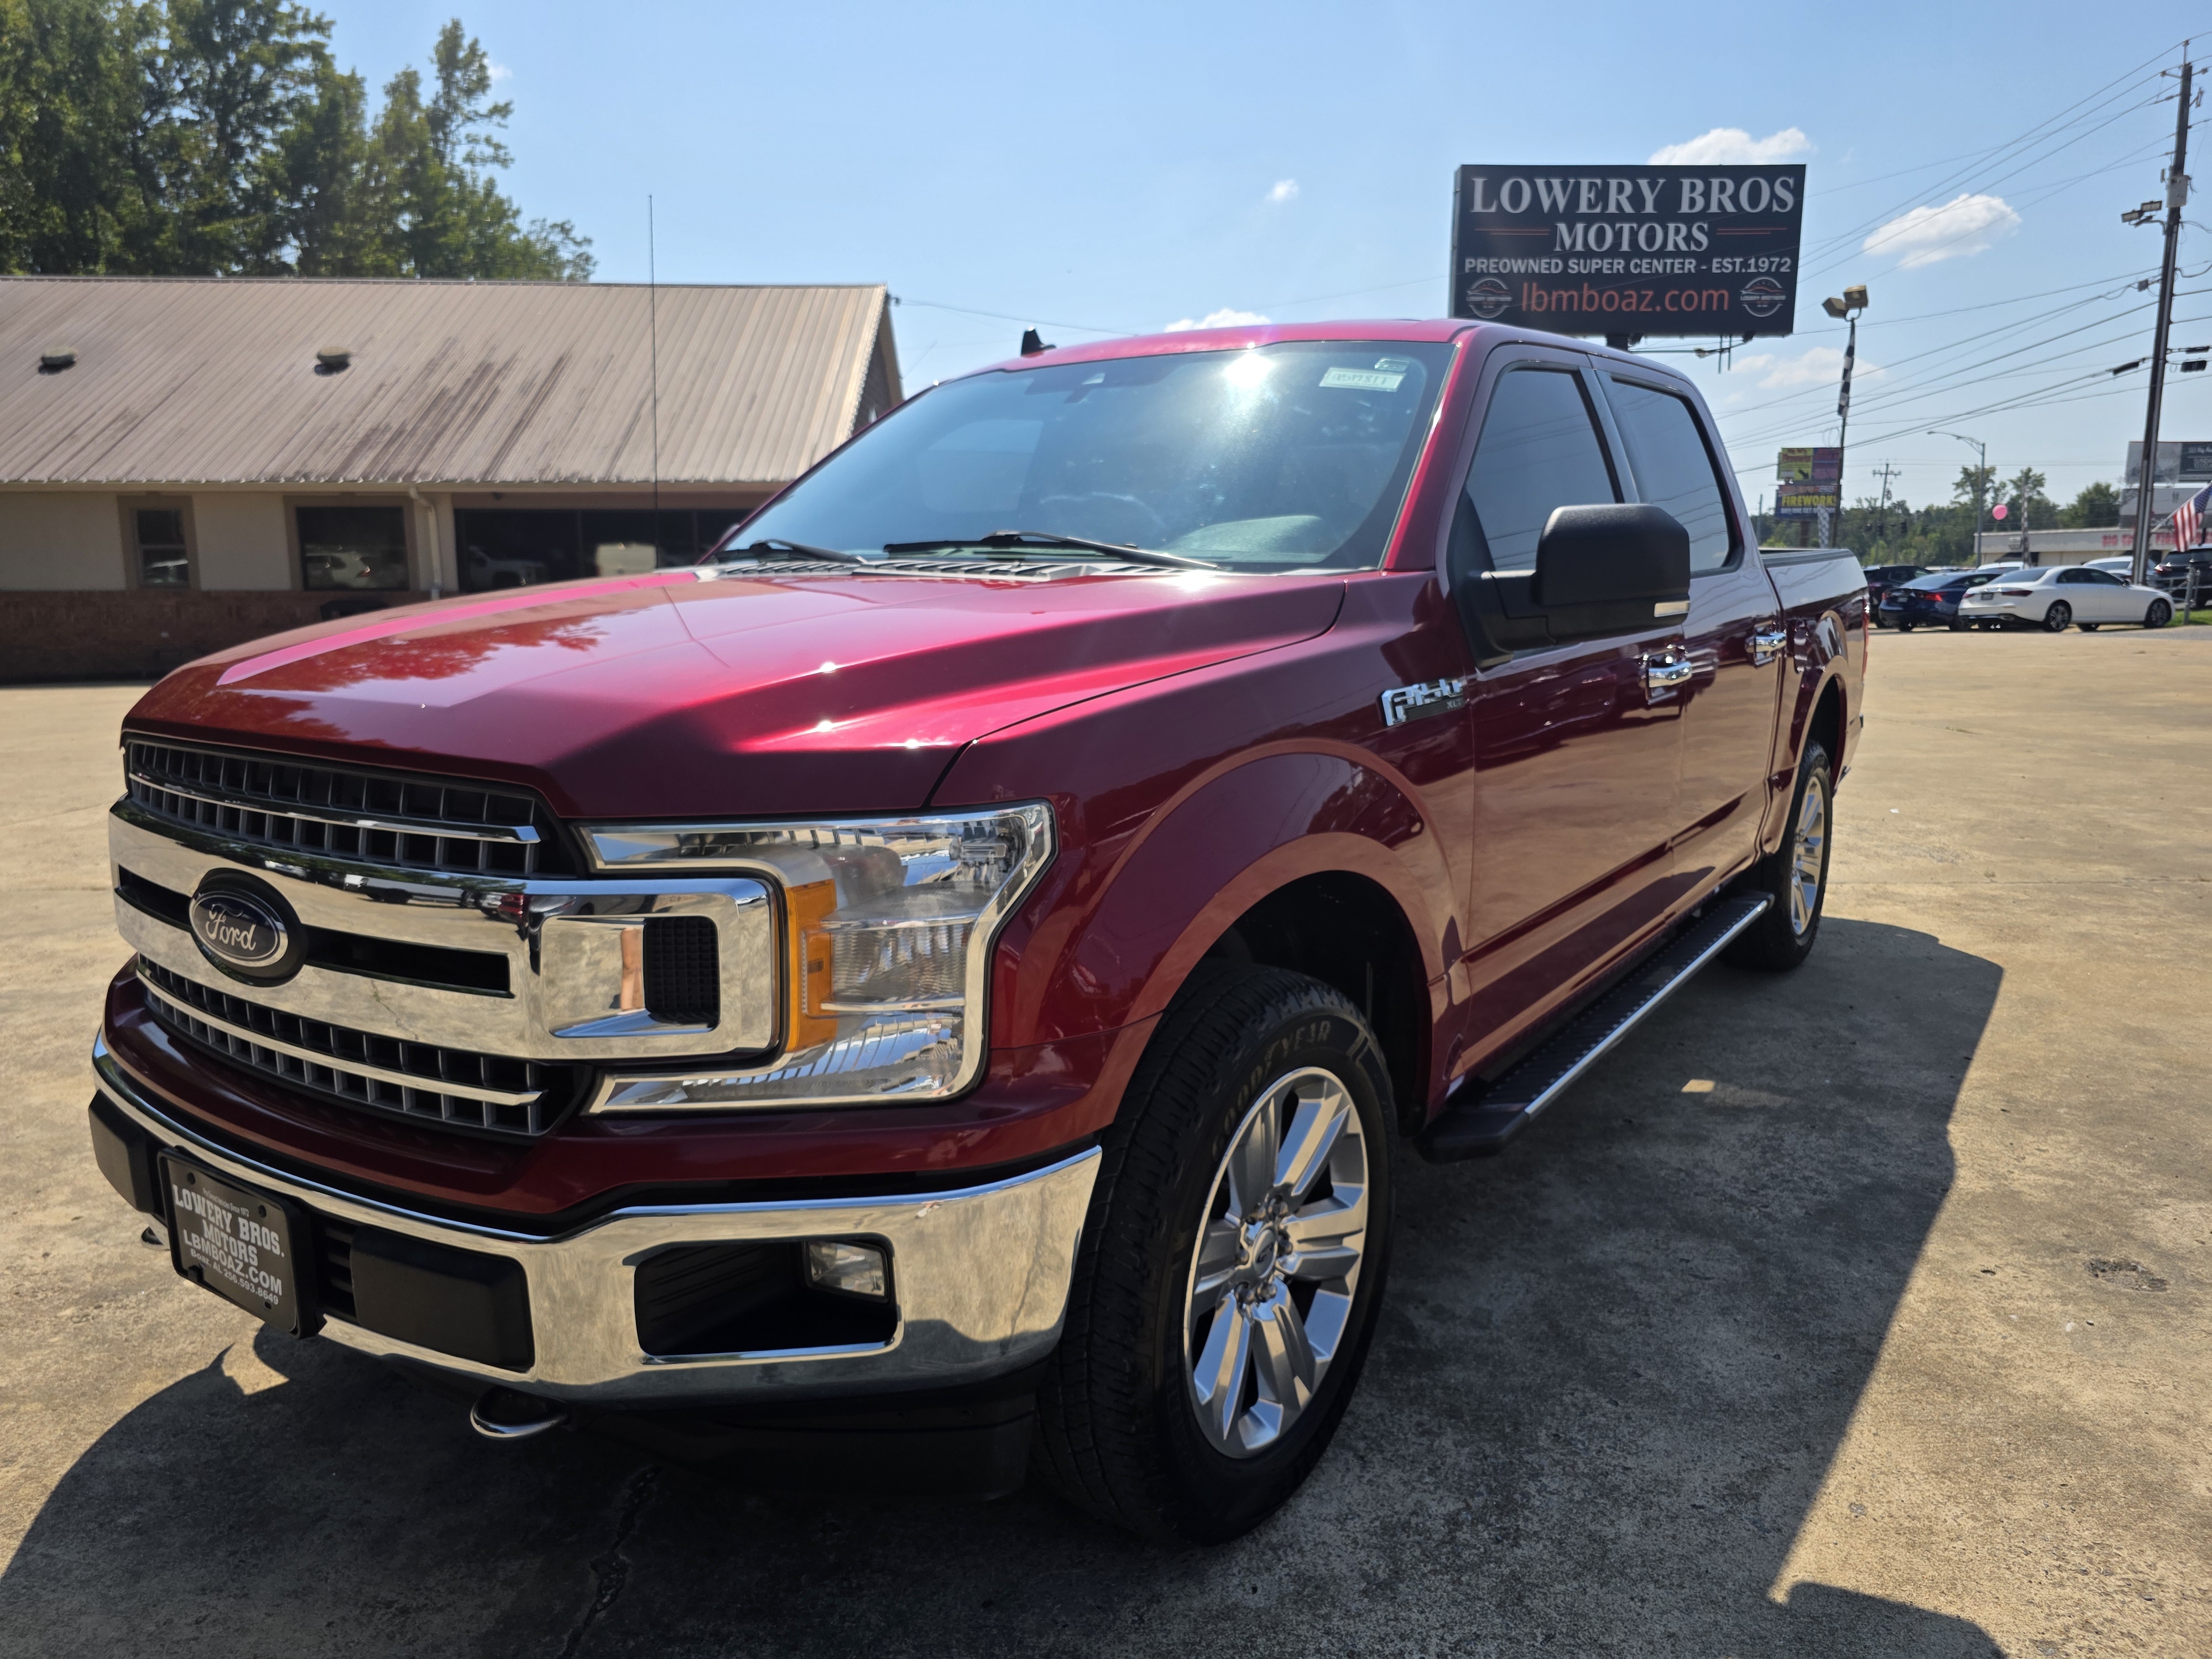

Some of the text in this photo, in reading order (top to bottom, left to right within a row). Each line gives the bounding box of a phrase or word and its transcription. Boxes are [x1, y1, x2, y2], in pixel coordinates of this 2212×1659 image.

[1469, 176, 1795, 213] LOWERY BROS
[1553, 222, 1709, 252] MOTORS
[1465, 258, 1563, 274] PREOWNED
[1567, 259, 1625, 274] SUPER
[1630, 258, 1696, 274] CENTER
[1712, 257, 1792, 273] EST.1972
[1521, 281, 1729, 312] lbmboaz.com
[1446, 697, 1464, 709] XLT
[205, 903, 257, 951] Ford
[173, 1184, 232, 1233] LOWERY
[238, 1217, 285, 1258] BROS.
[184, 1229, 283, 1296] LBMBOAZ.COM
[202, 1219, 258, 1267] MOTORS
[213, 1261, 223, 1274] AL
[223, 1268, 279, 1306] 256.593.8649
